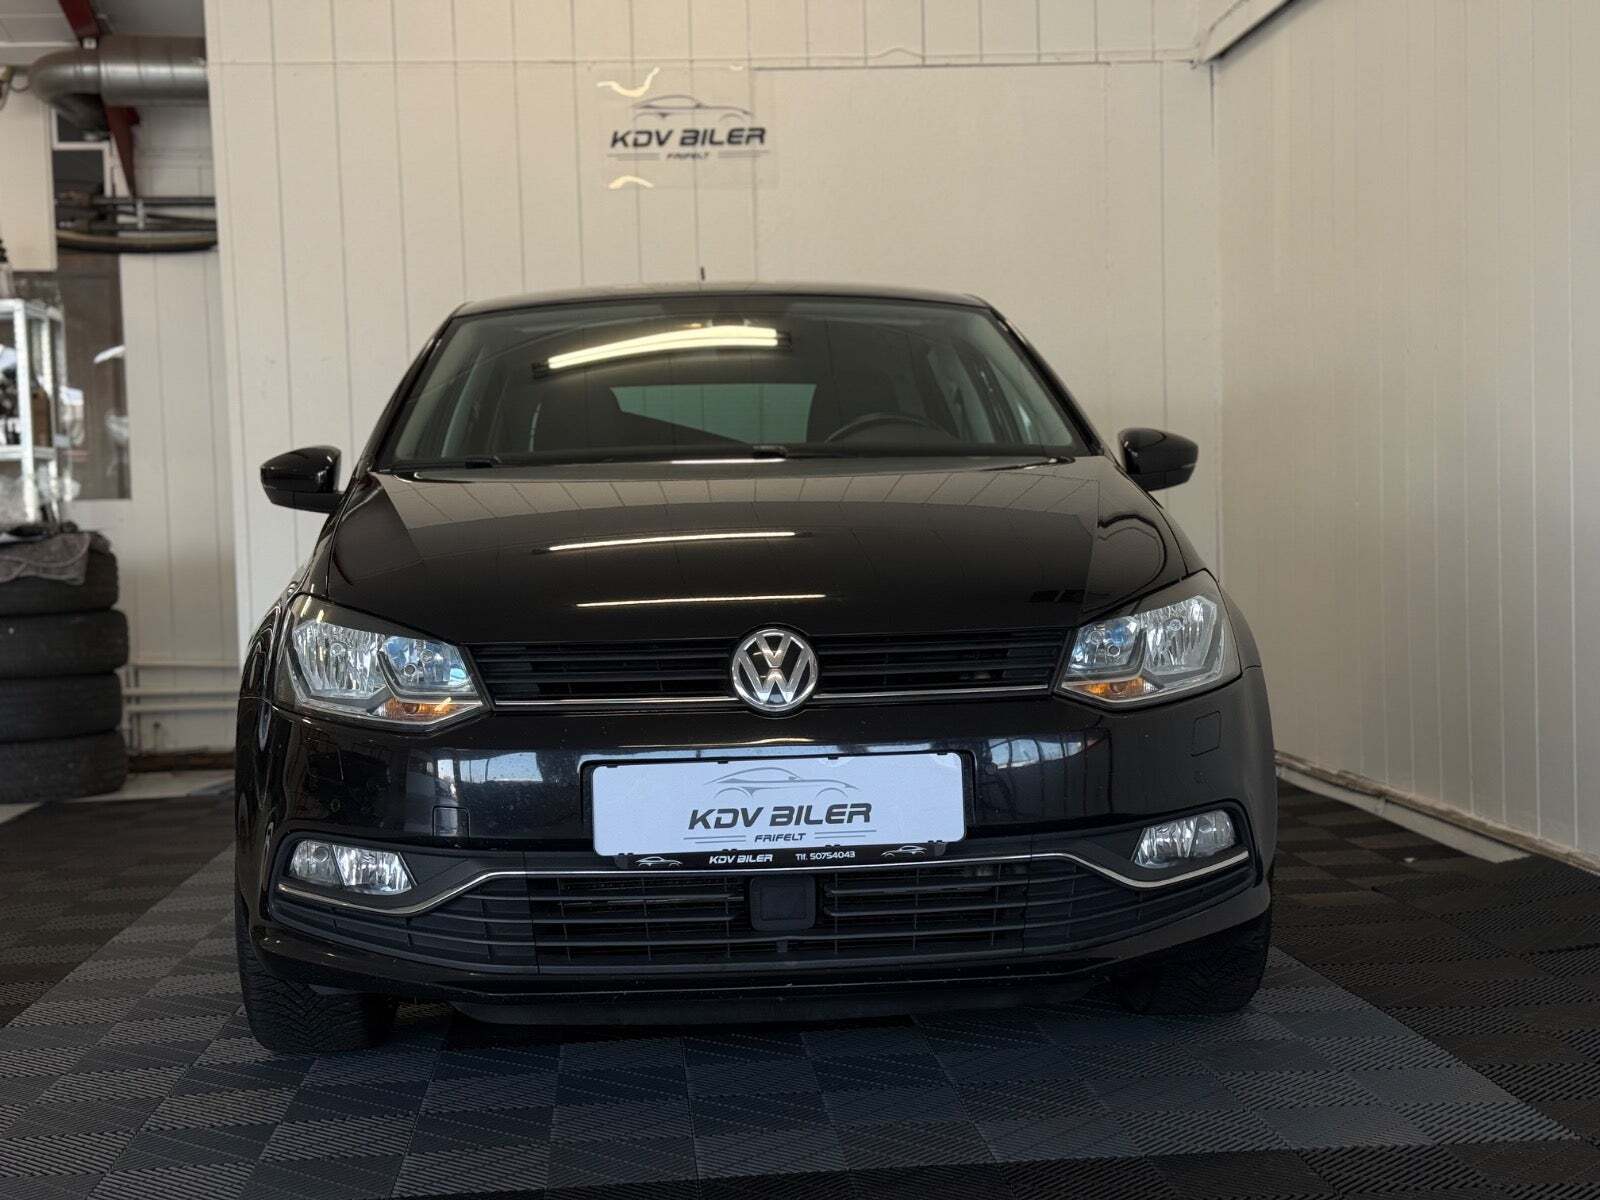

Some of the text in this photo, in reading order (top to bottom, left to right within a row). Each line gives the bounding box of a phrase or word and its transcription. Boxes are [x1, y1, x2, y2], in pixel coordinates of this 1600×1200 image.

[610, 127, 766, 149] KDV BILER
[732, 628, 818, 711] VW
[688, 802, 872, 830] KDV BILER
[754, 832, 806, 843] FRIFELT
[708, 855, 736, 865] KDV
[736, 853, 774, 864] BILER
[810, 850, 856, 861] 50754043
